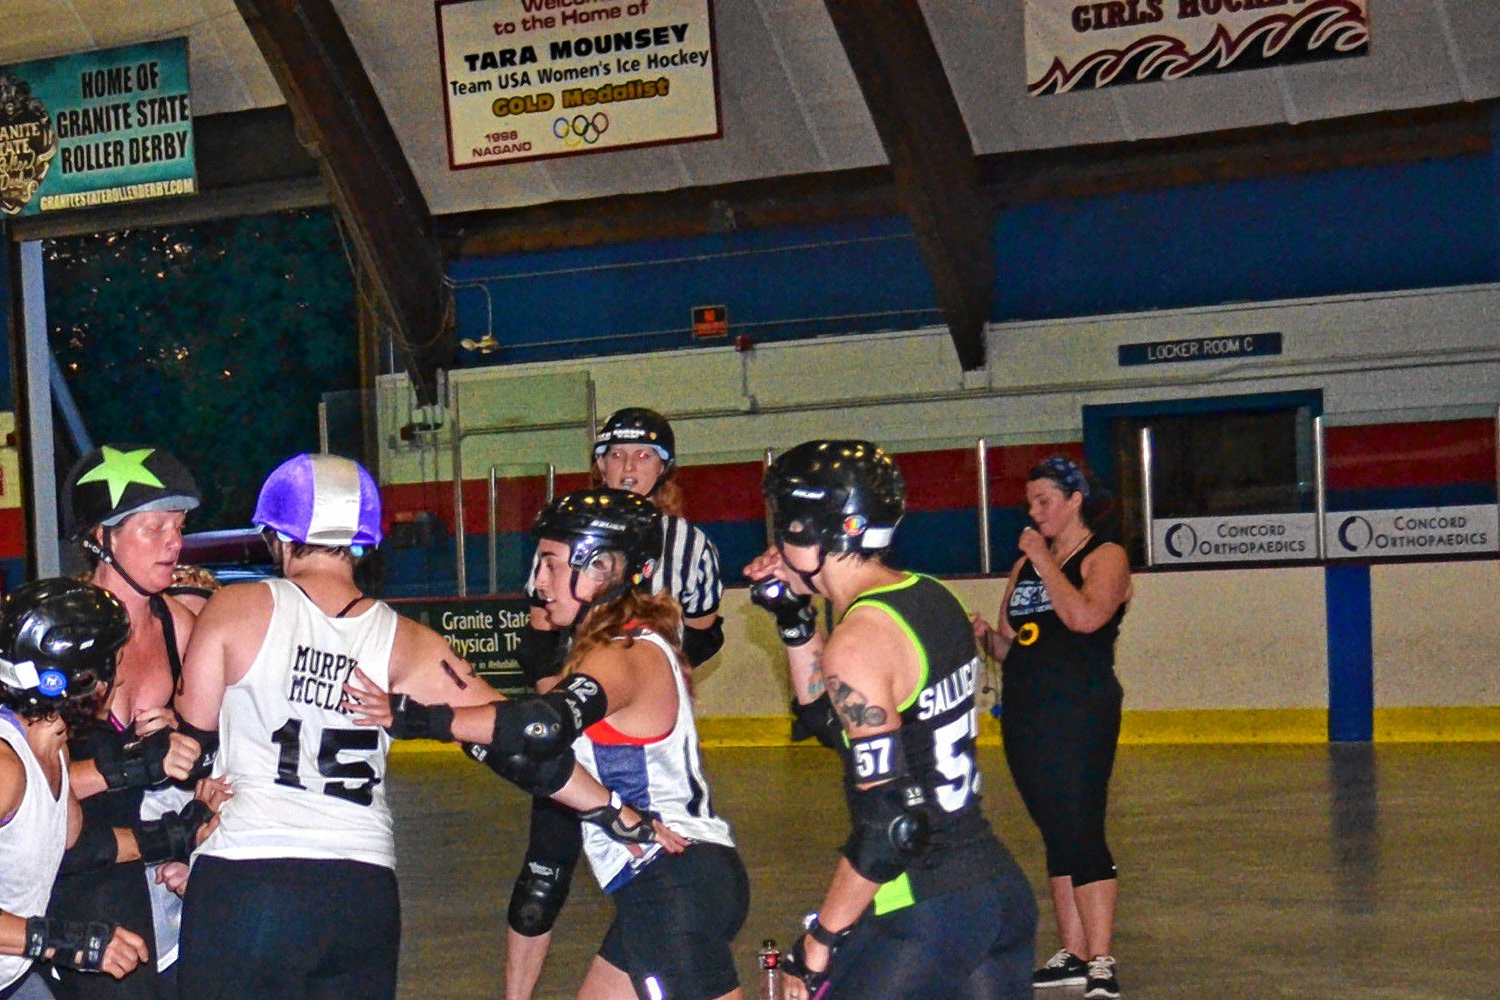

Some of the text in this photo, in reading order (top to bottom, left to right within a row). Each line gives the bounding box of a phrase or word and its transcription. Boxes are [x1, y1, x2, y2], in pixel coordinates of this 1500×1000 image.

[493, 0, 651, 36] to the Home of
[1071, 0, 1164, 33] GIRLS
[464, 23, 689, 73] TARA MOUNSEY
[81, 61, 159, 99] HOME OF
[450, 48, 710, 97] Team USA Women's Ice Hockey
[492, 76, 670, 117] GOLD Medalist
[56, 94, 189, 139] GRANITE STATE
[61, 130, 188, 175] ROLLER DERBY
[472, 141, 532, 158] NAGANO
[40, 178, 194, 212] GRANITESTATEROLLERDERBY.COM
[1148, 337, 1253, 360] LOCKER ROOM C
[442, 610, 493, 630] Granite
[567, 677, 599, 703] 12
[271, 718, 381, 806] 15
[853, 737, 892, 778] 57
